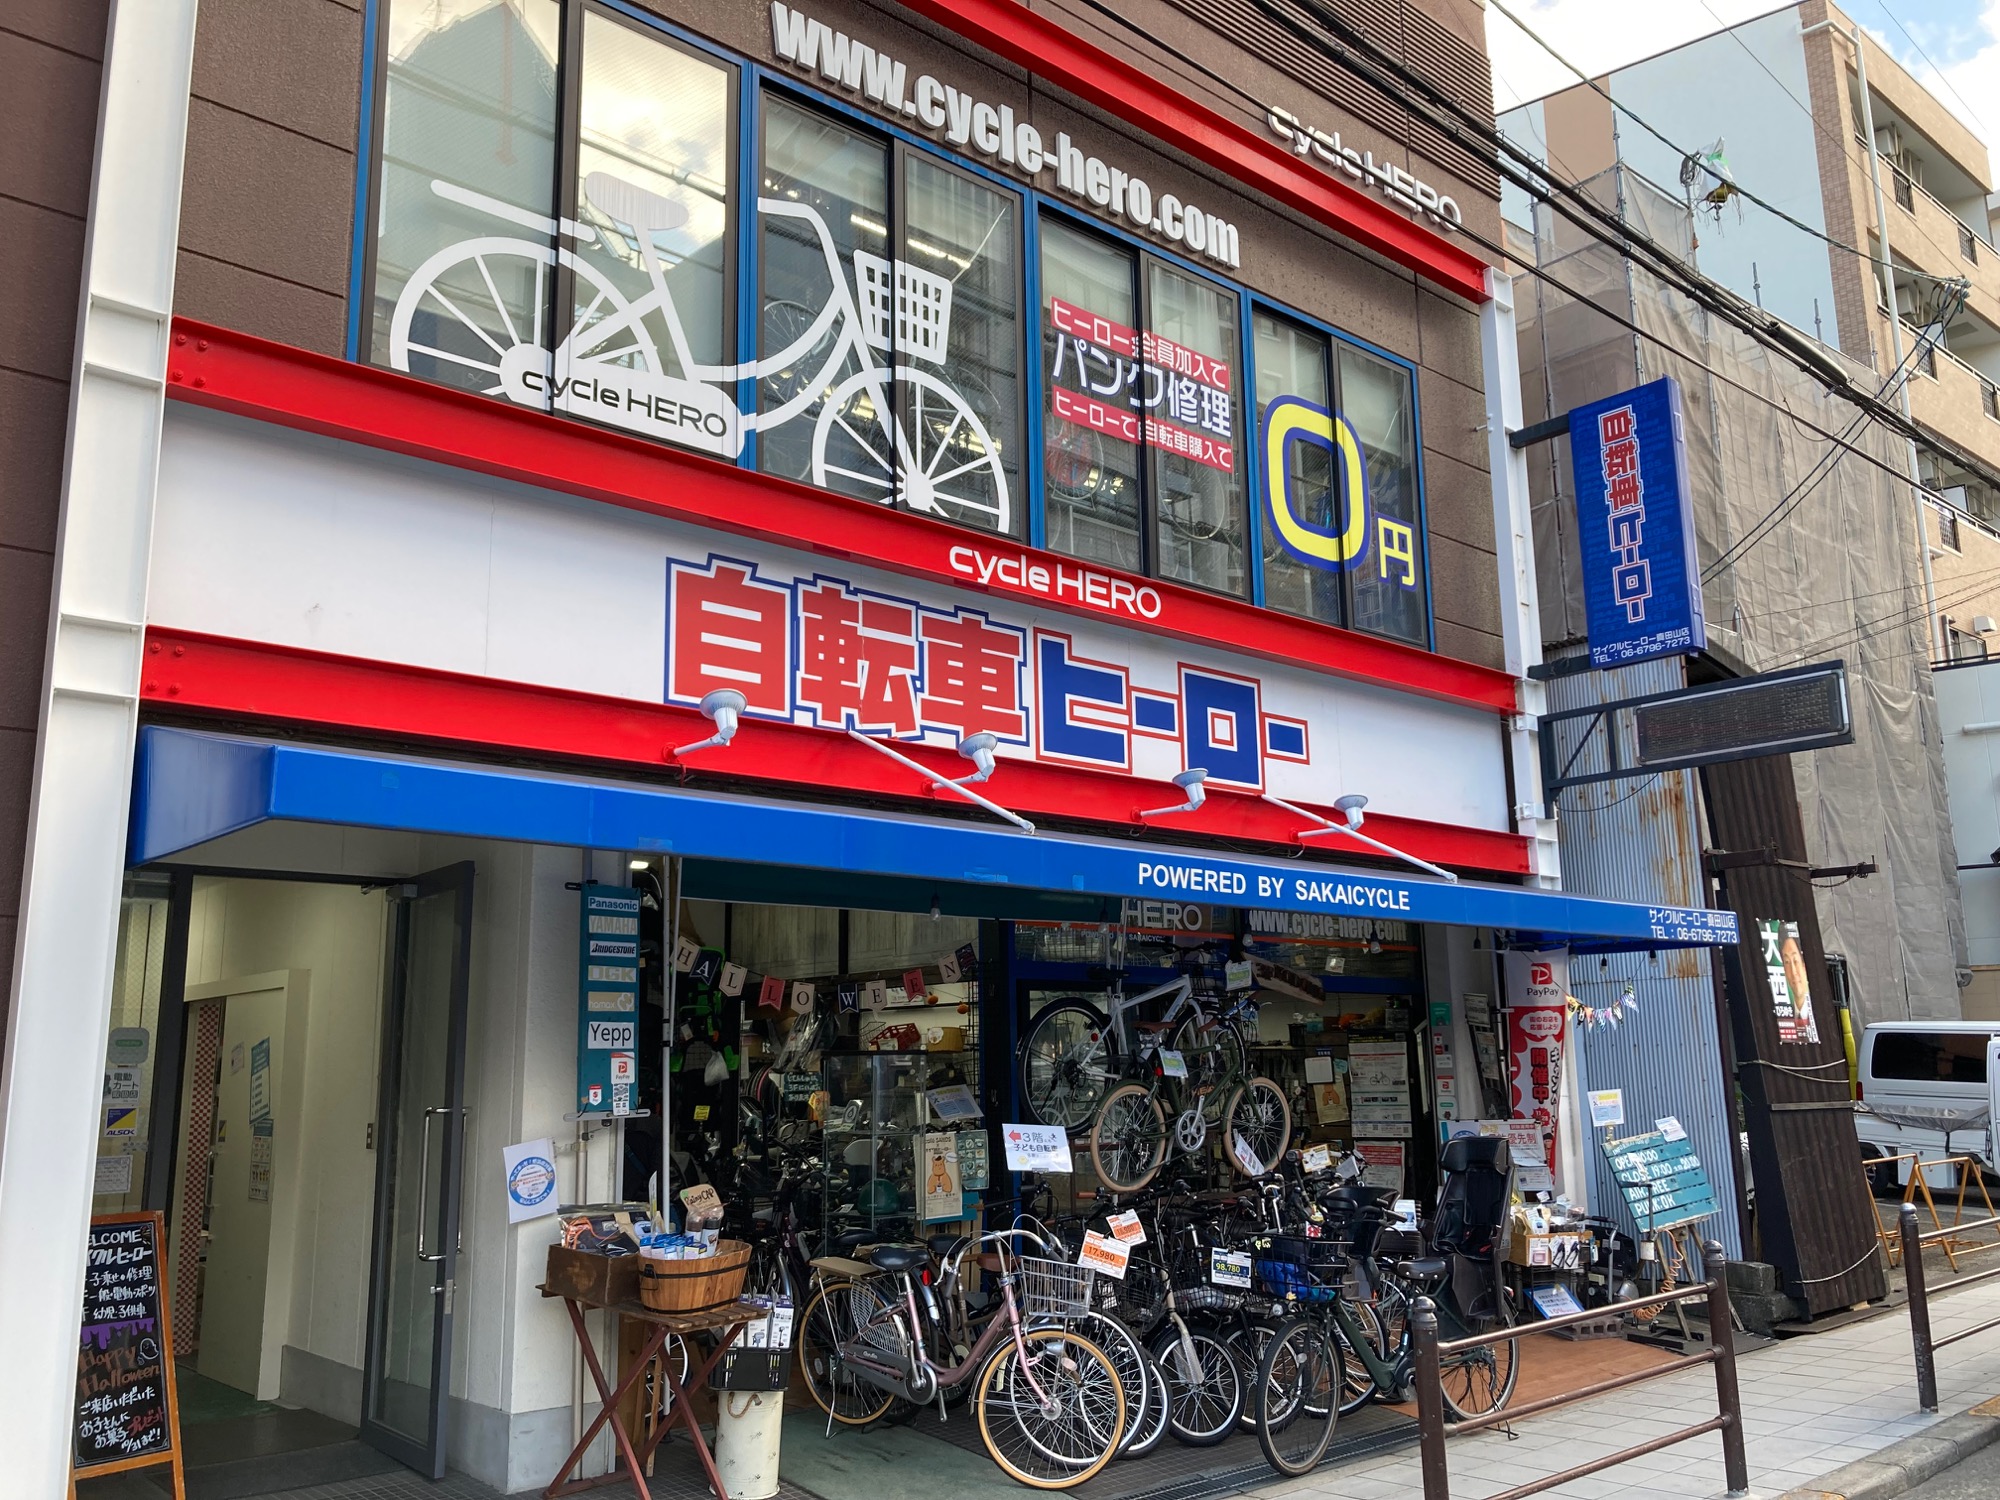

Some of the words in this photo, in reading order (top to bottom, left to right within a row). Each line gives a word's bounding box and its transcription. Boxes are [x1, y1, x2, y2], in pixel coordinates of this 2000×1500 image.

[771, 0, 1239, 269] www.cycle-hero.com
[1267, 106, 1362, 180] cycle
[1363, 150, 1462, 232] HERO
[1053, 300, 1228, 388] ヒーロー会員加入で
[521, 369, 620, 407] cycle
[626, 393, 728, 438] HERO
[1052, 331, 1232, 439] パンク修理
[1053, 389, 1232, 471] ヒーローで自転車購入で
[1598, 404, 1653, 624] 自転車ヒーロー
[949, 545, 1050, 591] cycle
[1056, 562, 1162, 619] HERO
[664, 553, 1310, 795] 自転車ヒーロー
[589, 897, 637, 911] Panasonic
[1139, 862, 1247, 896] POWERED
[1258, 875, 1285, 900] BY
[1295, 880, 1411, 912] SAKAICYCLE
[590, 916, 637, 934] YAMAHA
[592, 943, 635, 955] BRIDGESTONE
[1677, 927, 1738, 944] 06-6796-7273
[590, 966, 635, 982] OGK
[1526, 986, 1559, 997] PayPay
[591, 1024, 631, 1046] Yepp
[113, 1081, 139, 1090] カート
[79, 1364, 161, 1399] Halloween
